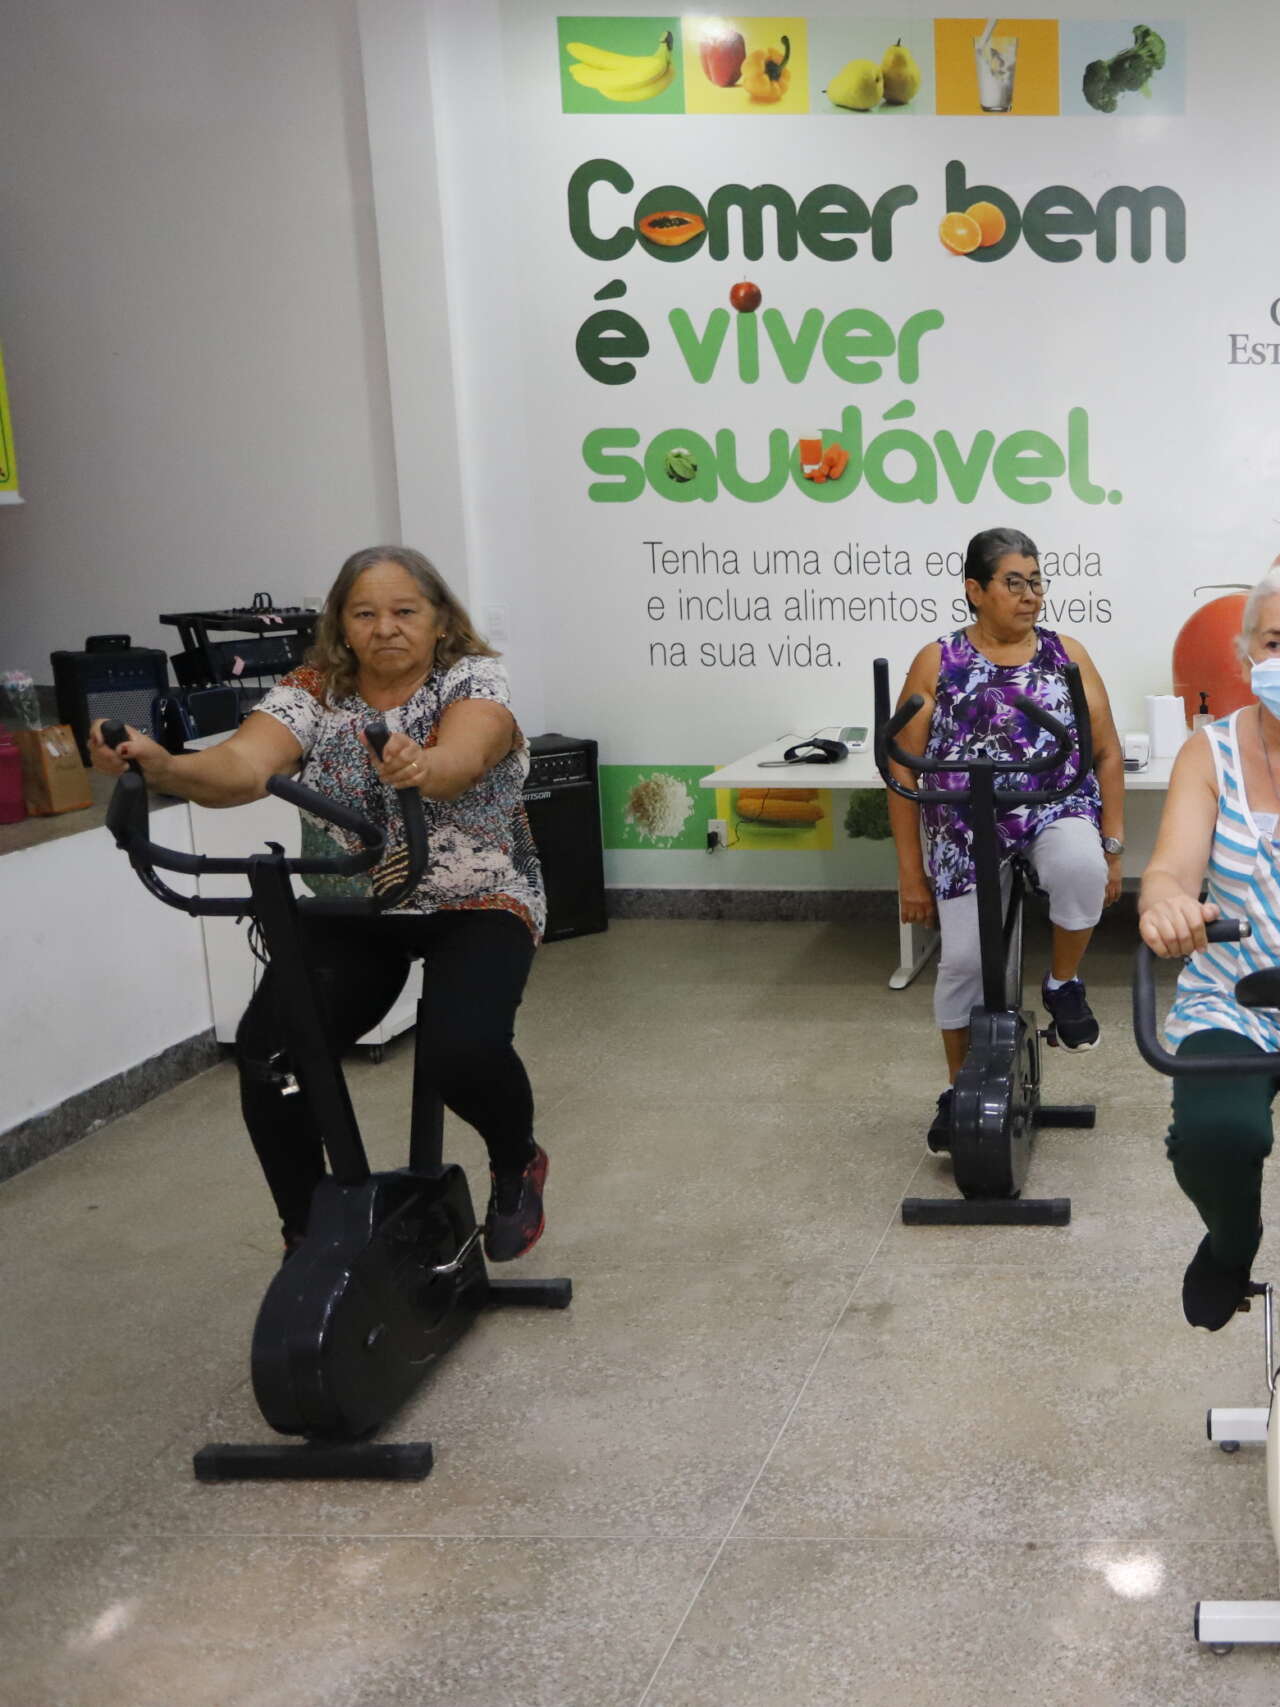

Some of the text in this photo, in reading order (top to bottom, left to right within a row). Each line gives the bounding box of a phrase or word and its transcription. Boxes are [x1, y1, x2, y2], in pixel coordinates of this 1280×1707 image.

[568, 158, 1186, 263] Comer bem
[576, 279, 945, 385] é viver
[582, 399, 1122, 505] saudável.
[643, 541, 741, 575] Tenha
[753, 550, 821, 576] uma
[834, 542, 912, 576] dieta
[648, 588, 1113, 624] e inclua alimentos sveis
[650, 635, 841, 668] na sua vida.
